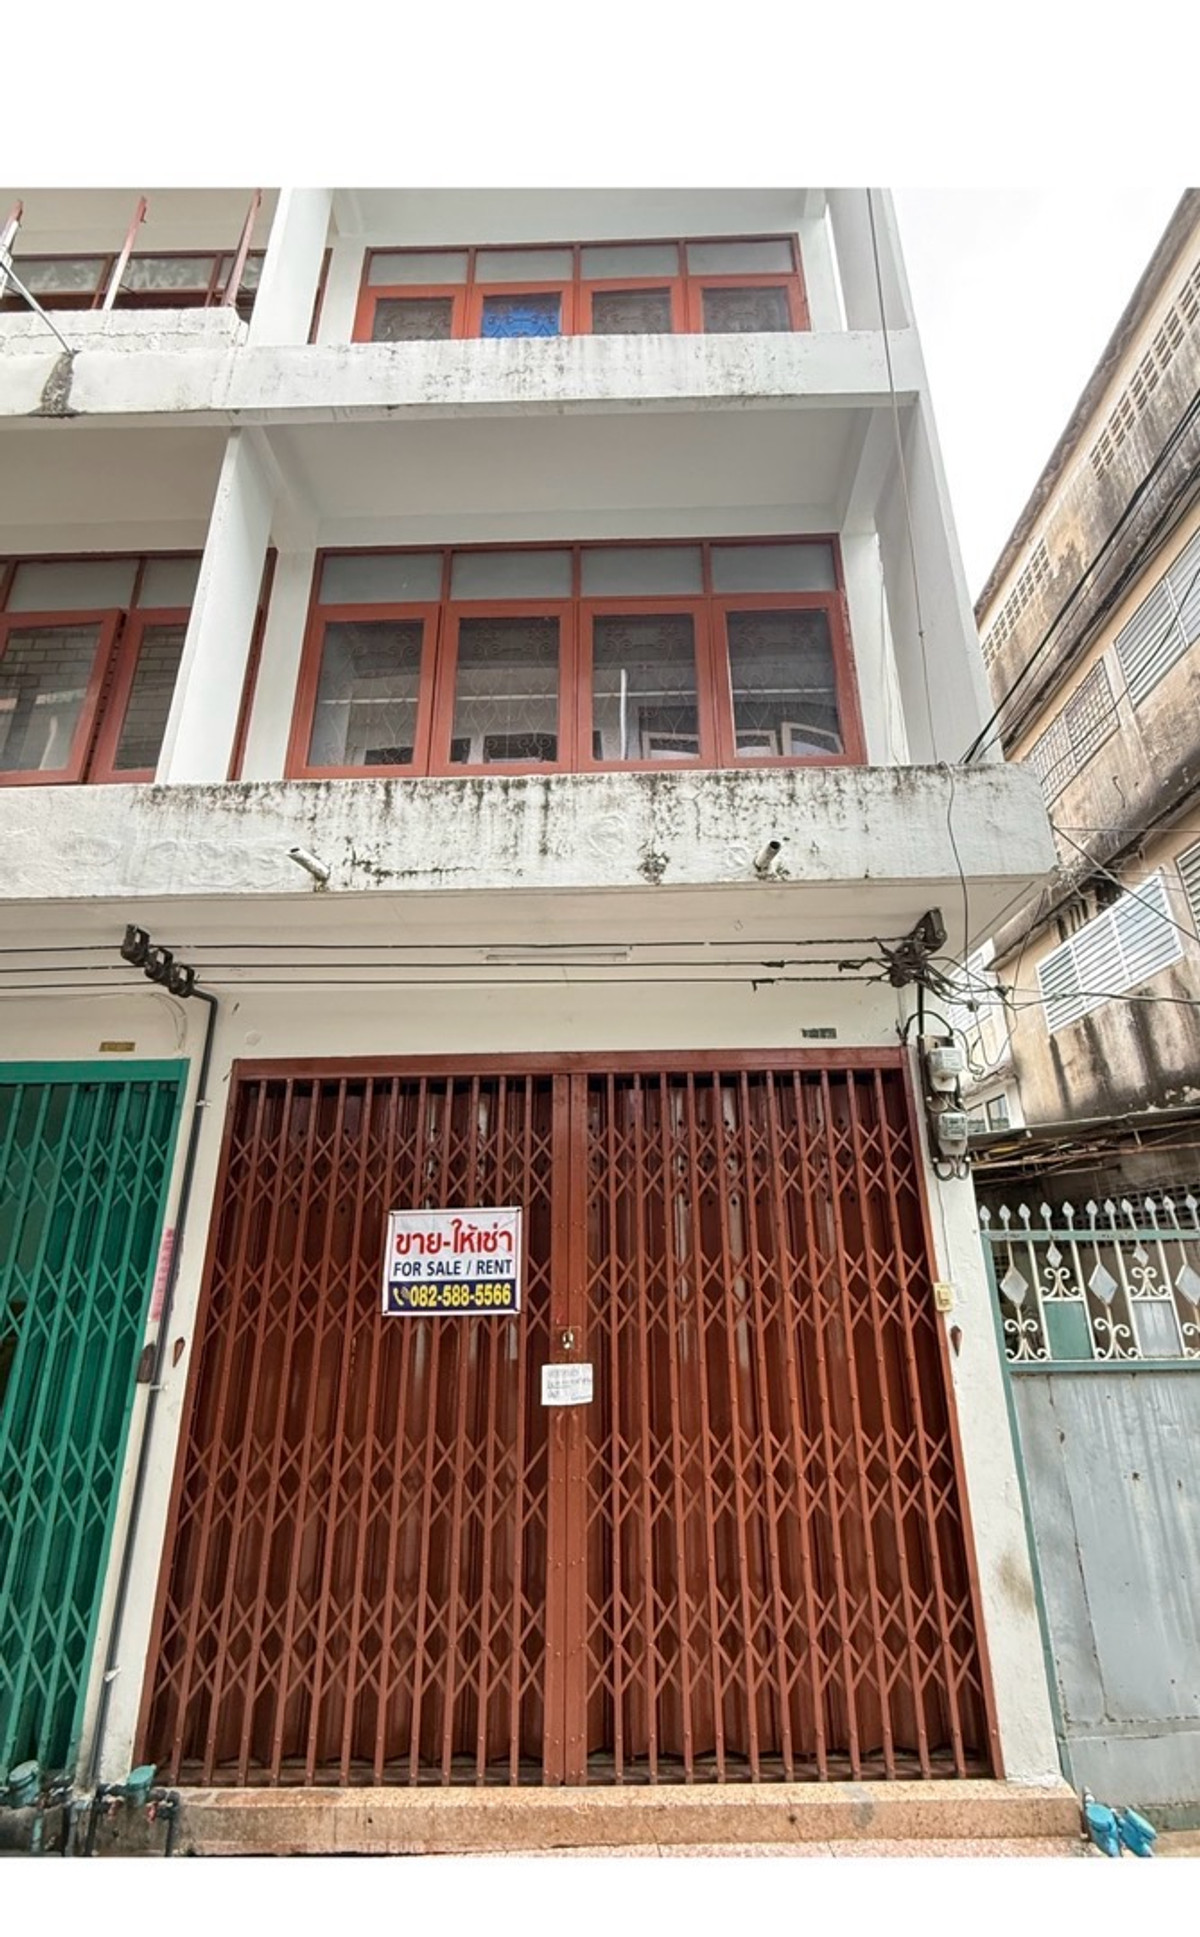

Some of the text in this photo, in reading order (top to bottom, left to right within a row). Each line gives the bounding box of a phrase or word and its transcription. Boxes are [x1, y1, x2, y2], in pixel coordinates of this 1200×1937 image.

[396, 1218, 513, 1255] ขาย-ให้เช่า
[393, 1259, 513, 1277] FOR SALE / RENT
[410, 1282, 511, 1307] 082-588-5566
